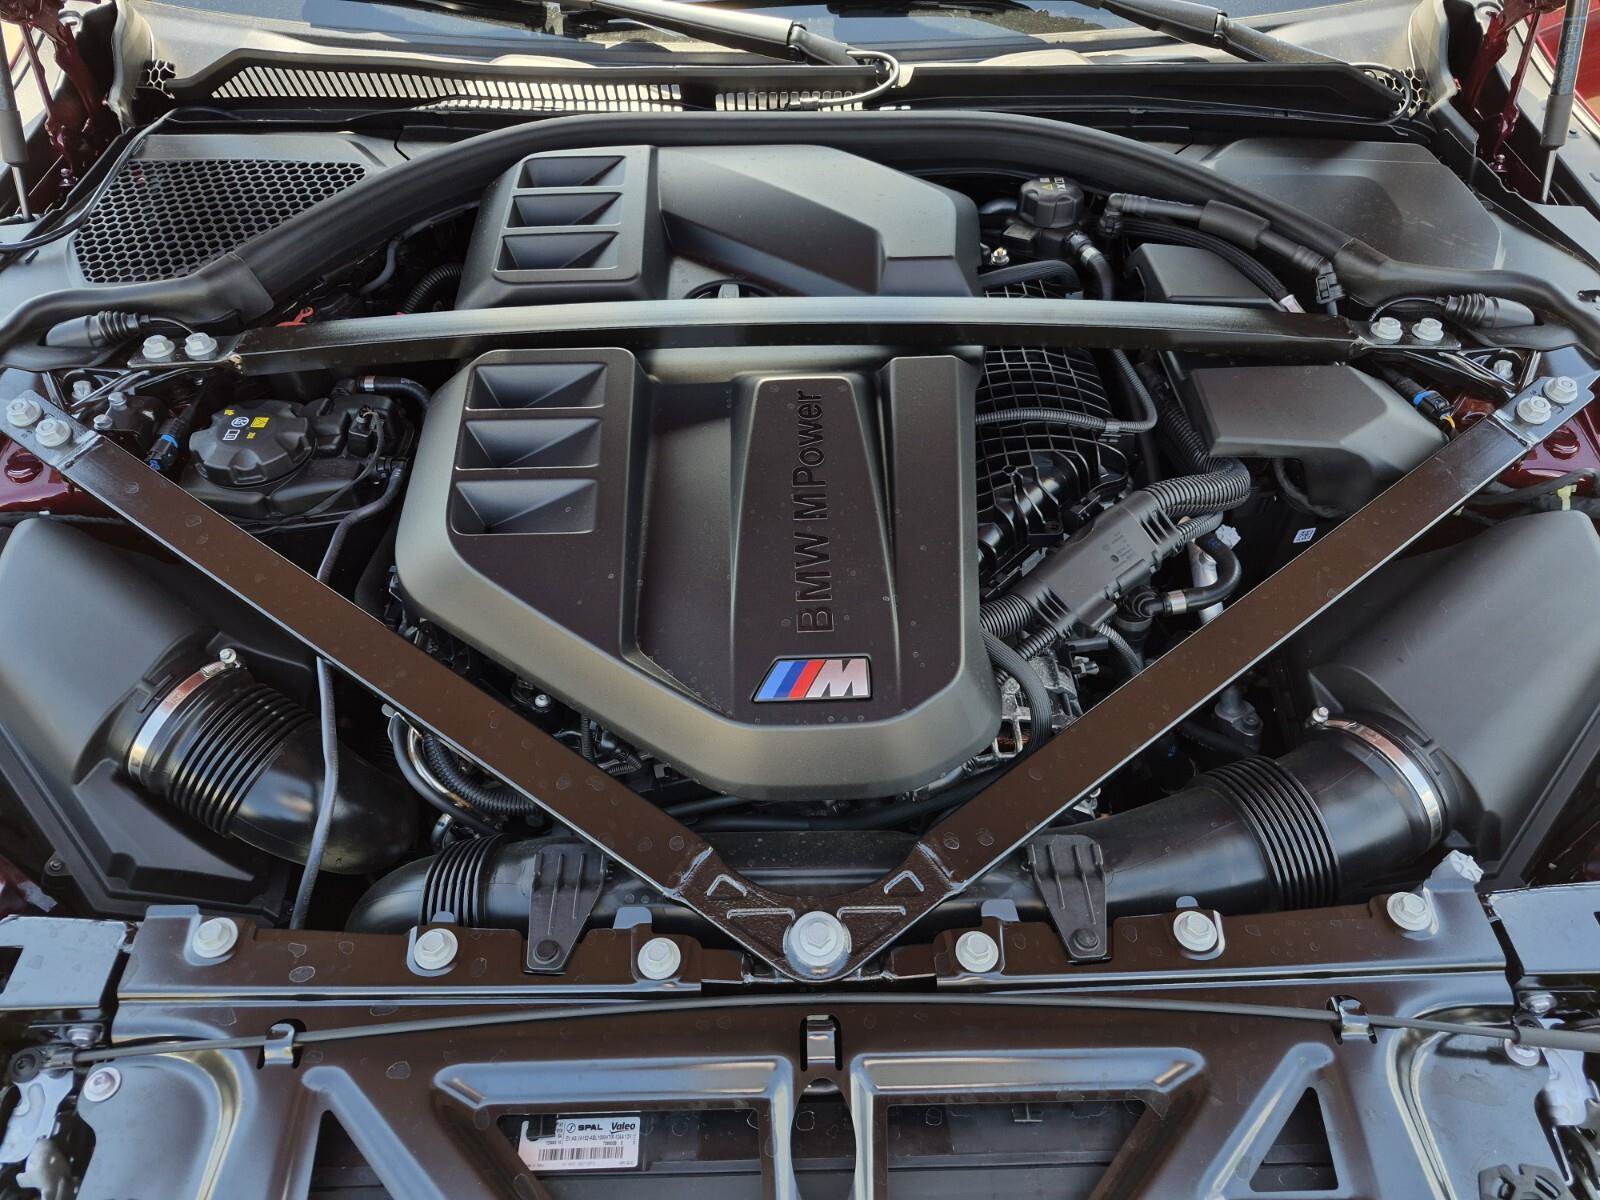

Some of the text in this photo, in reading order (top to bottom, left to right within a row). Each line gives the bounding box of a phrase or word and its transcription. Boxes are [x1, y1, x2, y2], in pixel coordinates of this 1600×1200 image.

[794, 532, 834, 633] BMW
[805, 659, 869, 697] M
[611, 1122, 636, 1131] Valeo
